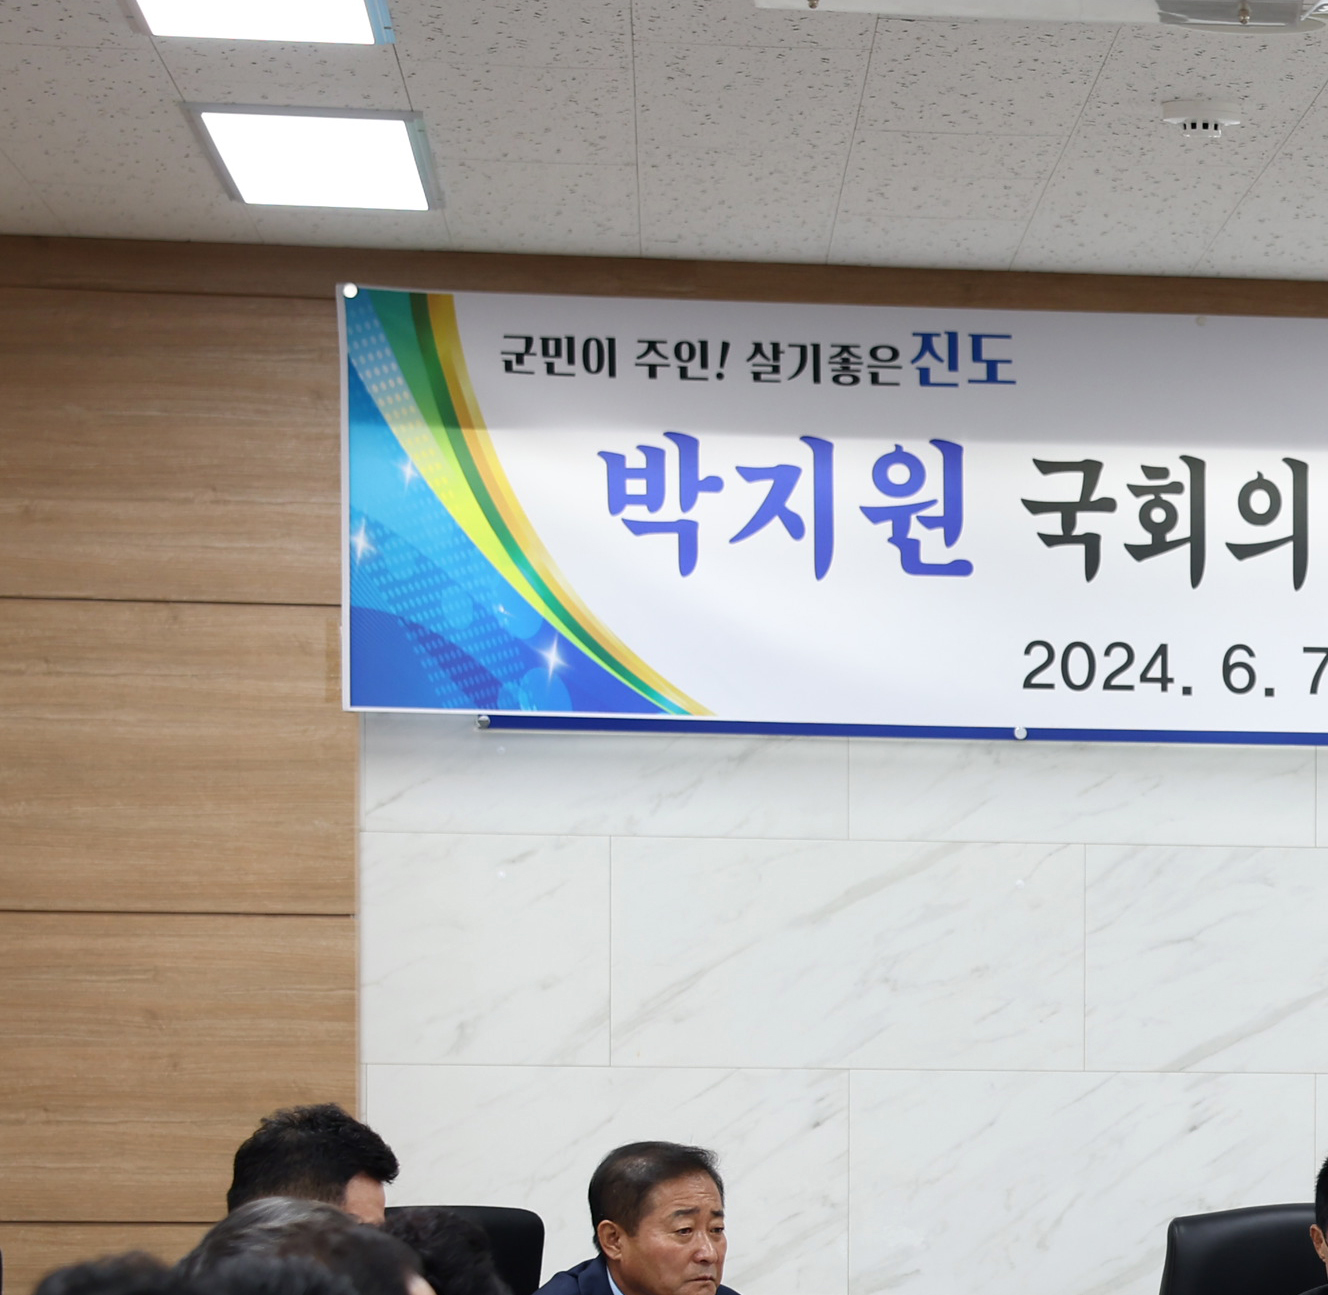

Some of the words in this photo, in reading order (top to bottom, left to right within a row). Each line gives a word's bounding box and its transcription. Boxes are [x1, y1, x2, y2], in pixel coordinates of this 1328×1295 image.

[501, 335, 616, 378] 군민이
[635, 340, 730, 381] 주인!
[596, 431, 975, 580] 박지원
[1023, 640, 1192, 696] 2024.
[1222, 644, 1274, 697] 6.
